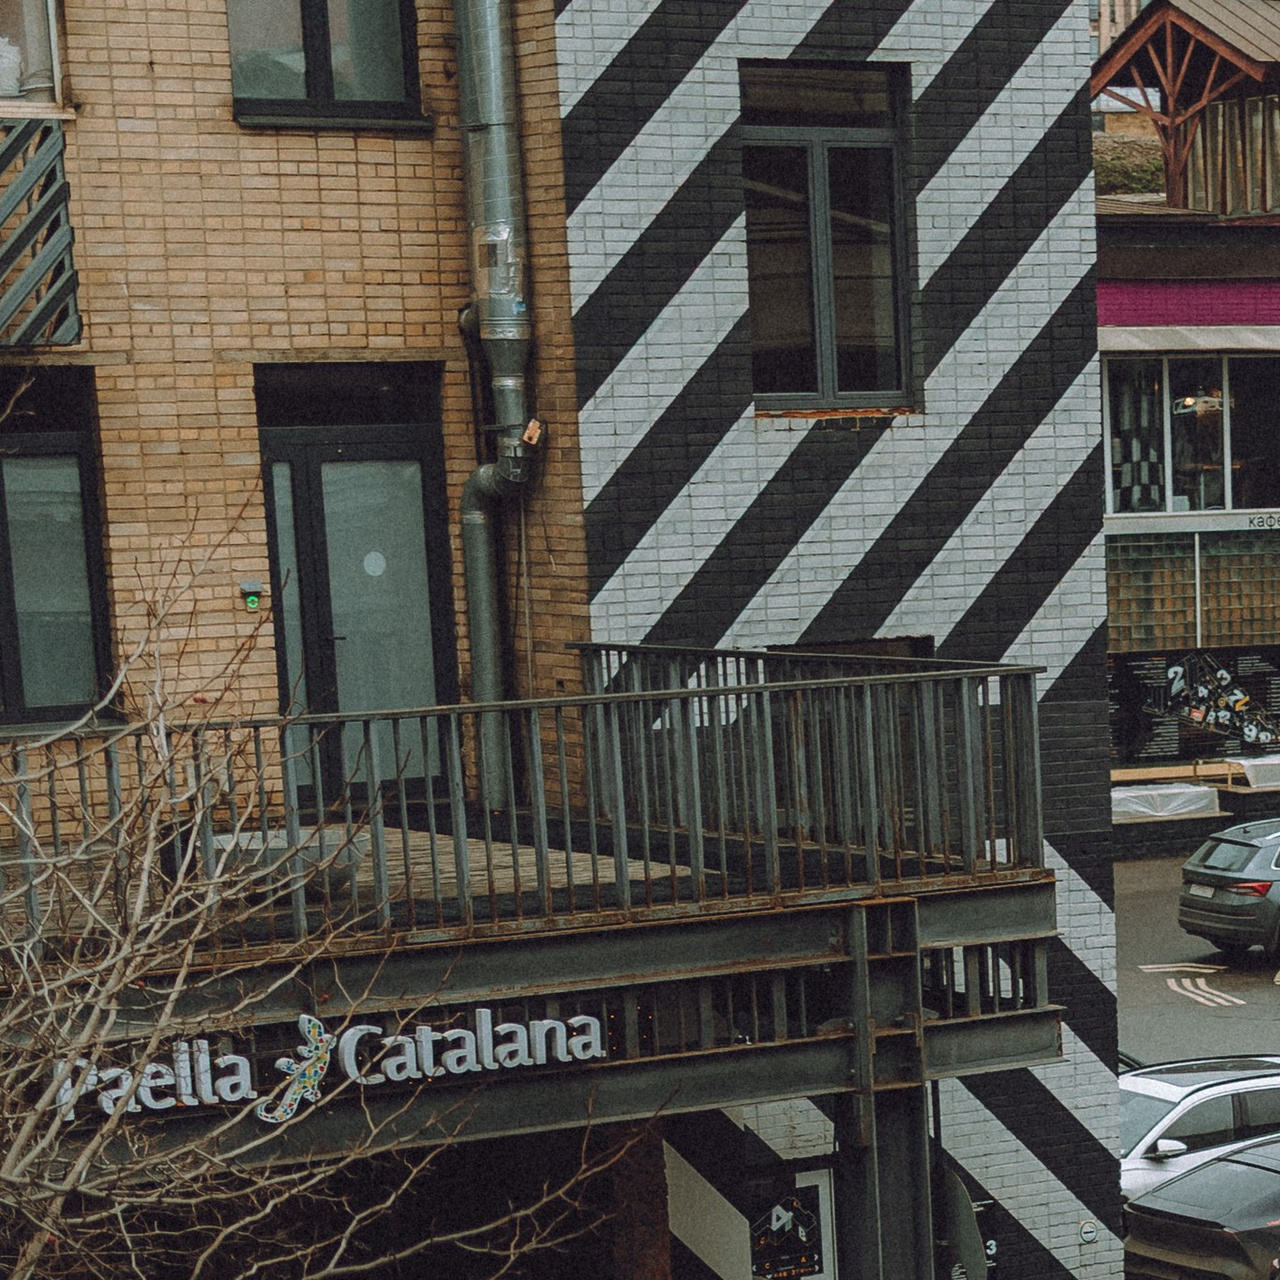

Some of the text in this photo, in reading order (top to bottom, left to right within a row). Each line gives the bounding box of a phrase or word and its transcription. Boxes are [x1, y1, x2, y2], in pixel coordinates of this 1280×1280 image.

[52, 1008, 607, 1121] Paella Catalana
[986, 1240, 997, 1255] 3
